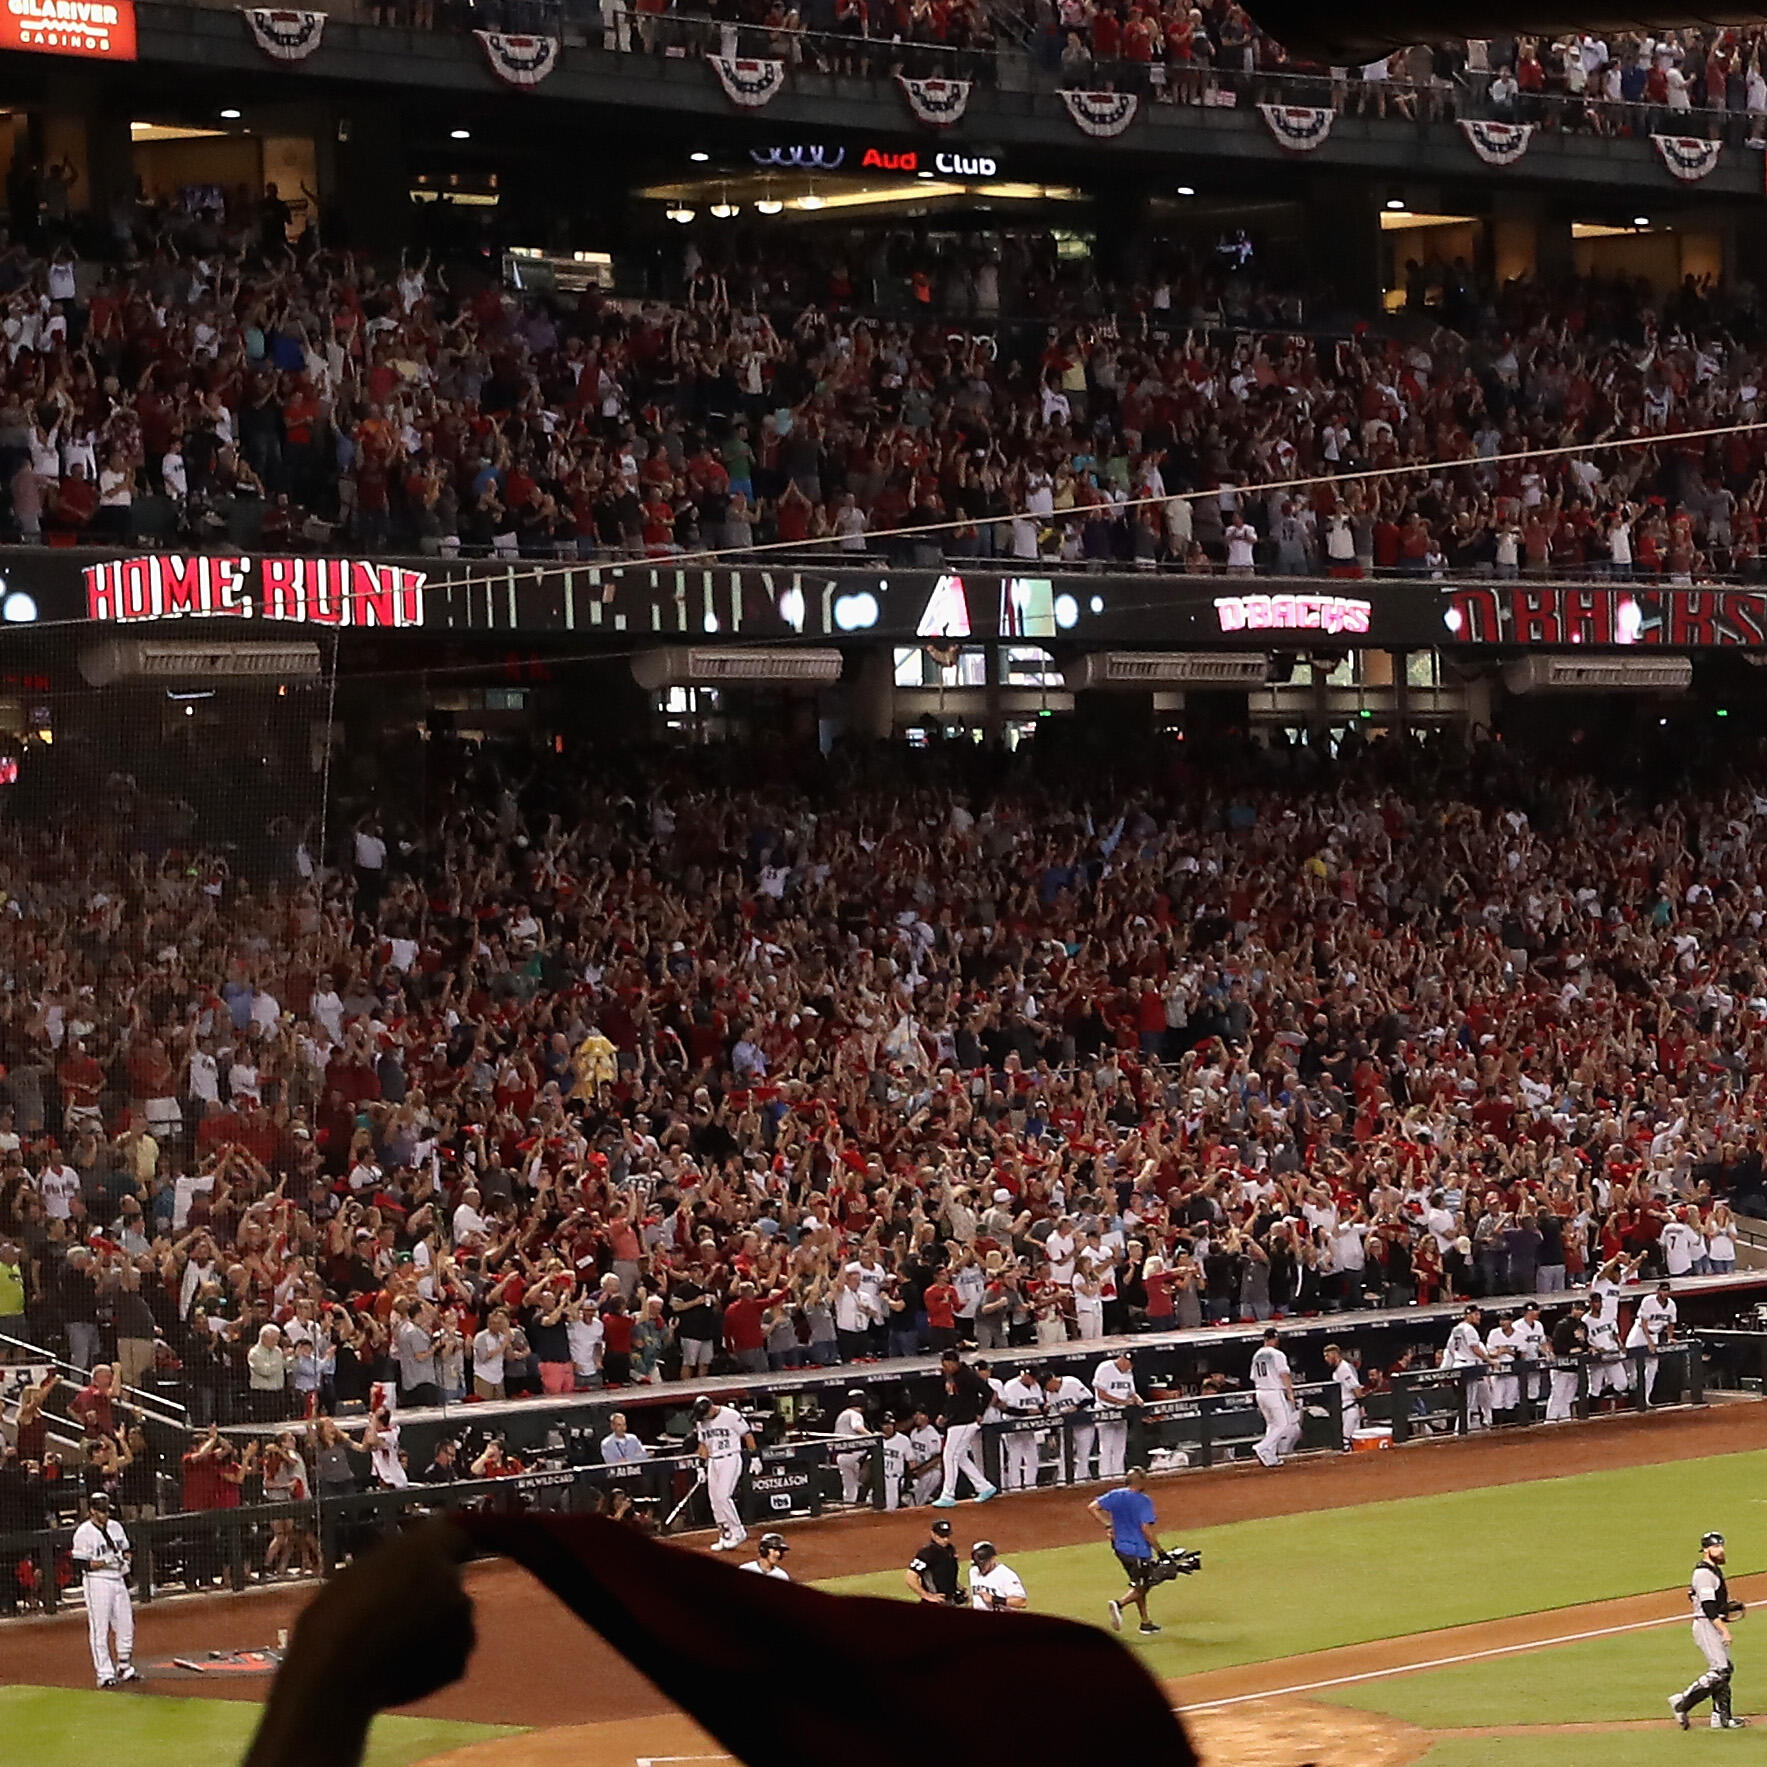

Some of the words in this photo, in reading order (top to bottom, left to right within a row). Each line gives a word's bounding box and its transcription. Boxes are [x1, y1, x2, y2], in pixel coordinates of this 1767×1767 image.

[20, 30, 110, 50] CASINOS
[935, 153, 997, 176] Club
[82, 555, 252, 622] HOME
[1256, 1360, 1268, 1377] 10
[752, 1473, 809, 1491] POSTSEASON
